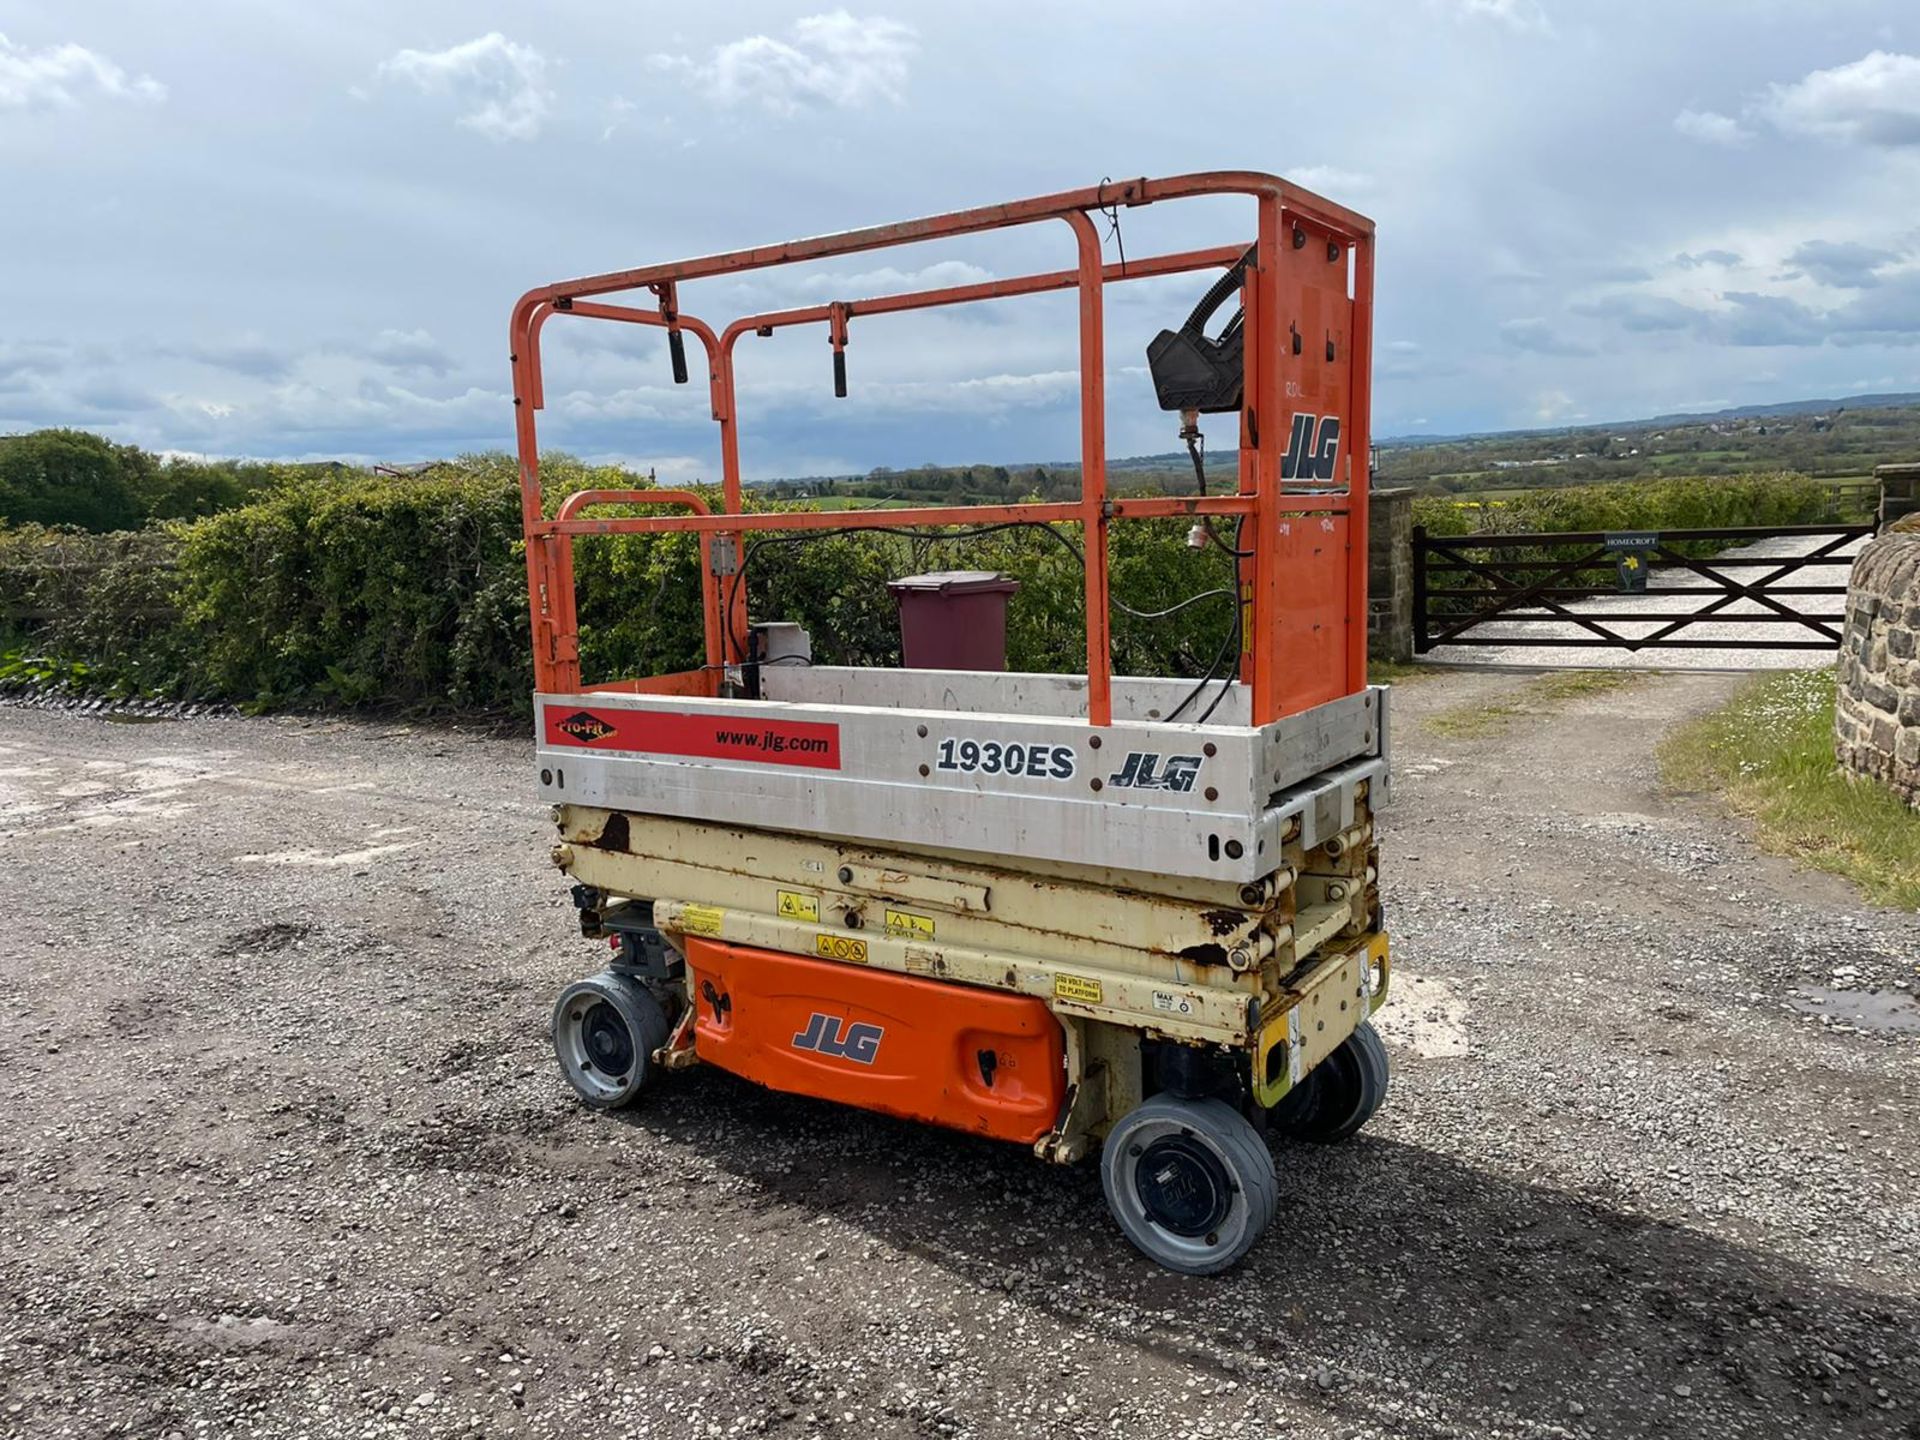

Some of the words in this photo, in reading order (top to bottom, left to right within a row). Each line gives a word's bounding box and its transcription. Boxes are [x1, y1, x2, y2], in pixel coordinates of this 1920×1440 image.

[1280, 412, 1341, 481] JLG
[1607, 537, 1656, 546] HOMECROFT
[716, 731, 829, 752] www.jlg.com
[938, 739, 1075, 778] 1930ES
[1108, 753, 1203, 792] JLG
[1067, 987, 1098, 998] PLATFORM
[1068, 978, 1082, 986] VOLT
[1156, 992, 1173, 1001] MAX
[792, 1012, 884, 1065] JLG
